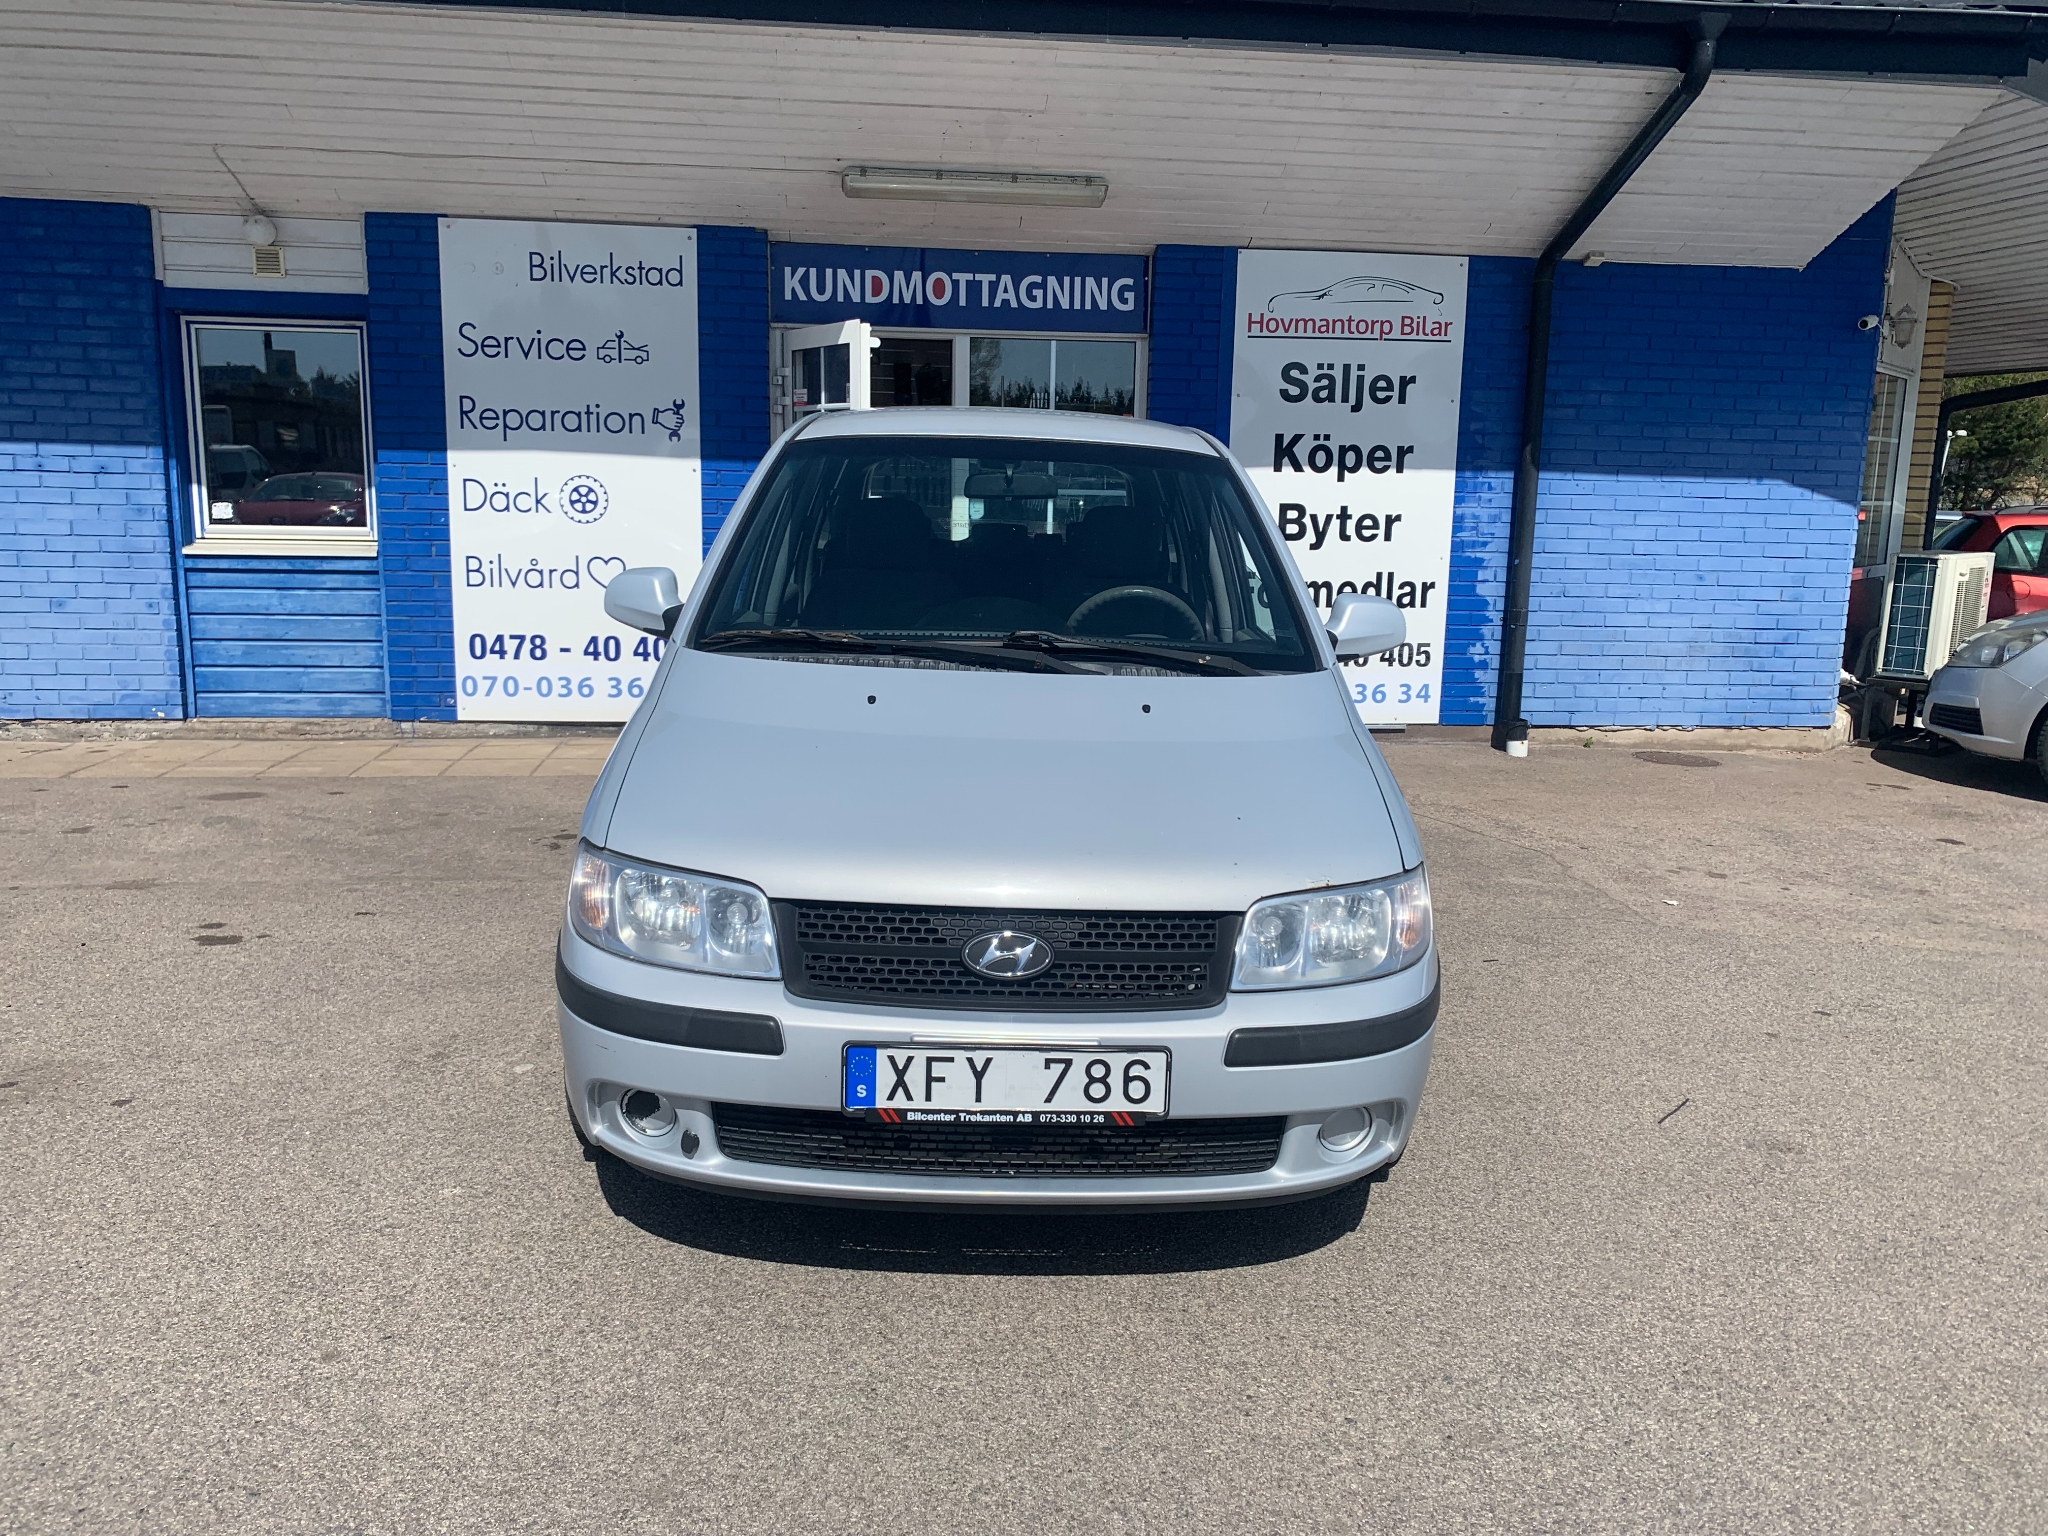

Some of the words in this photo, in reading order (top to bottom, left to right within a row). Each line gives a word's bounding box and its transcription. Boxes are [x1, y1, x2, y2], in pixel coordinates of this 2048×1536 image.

[528, 250, 684, 288] Bilverkstad
[784, 266, 1135, 312] KUNDMOTTAGNING
[457, 321, 587, 362] Service
[1247, 313, 1393, 341] Hovmantorp
[1400, 315, 1453, 337] Bilar
[1279, 361, 1417, 413] Säljer
[458, 395, 646, 442] Reparation
[1273, 432, 1415, 483] Köper
[462, 477, 553, 514] Däck
[1278, 502, 1402, 551] Byter
[465, 553, 581, 590] Bilvård
[469, 633, 548, 661] 0478
[583, 635, 622, 662] 40
[1379, 642, 1431, 668] 405
[461, 675, 595, 698] 070-036
[607, 676, 645, 699] 36
[1353, 683, 1387, 704] 36
[1397, 683, 1432, 704] 34
[856, 1084, 867, 1098] S
[885, 1054, 994, 1104] XFY
[1043, 1057, 1152, 1105] 786
[906, 1111, 956, 1122] Bilcenter
[959, 1112, 1014, 1122] Trekanten
[1016, 1113, 1033, 1123] AB
[1039, 1113, 1077, 1123] 073-330
[1079, 1114, 1091, 1123] 10
[1092, 1114, 1105, 1123] 26
